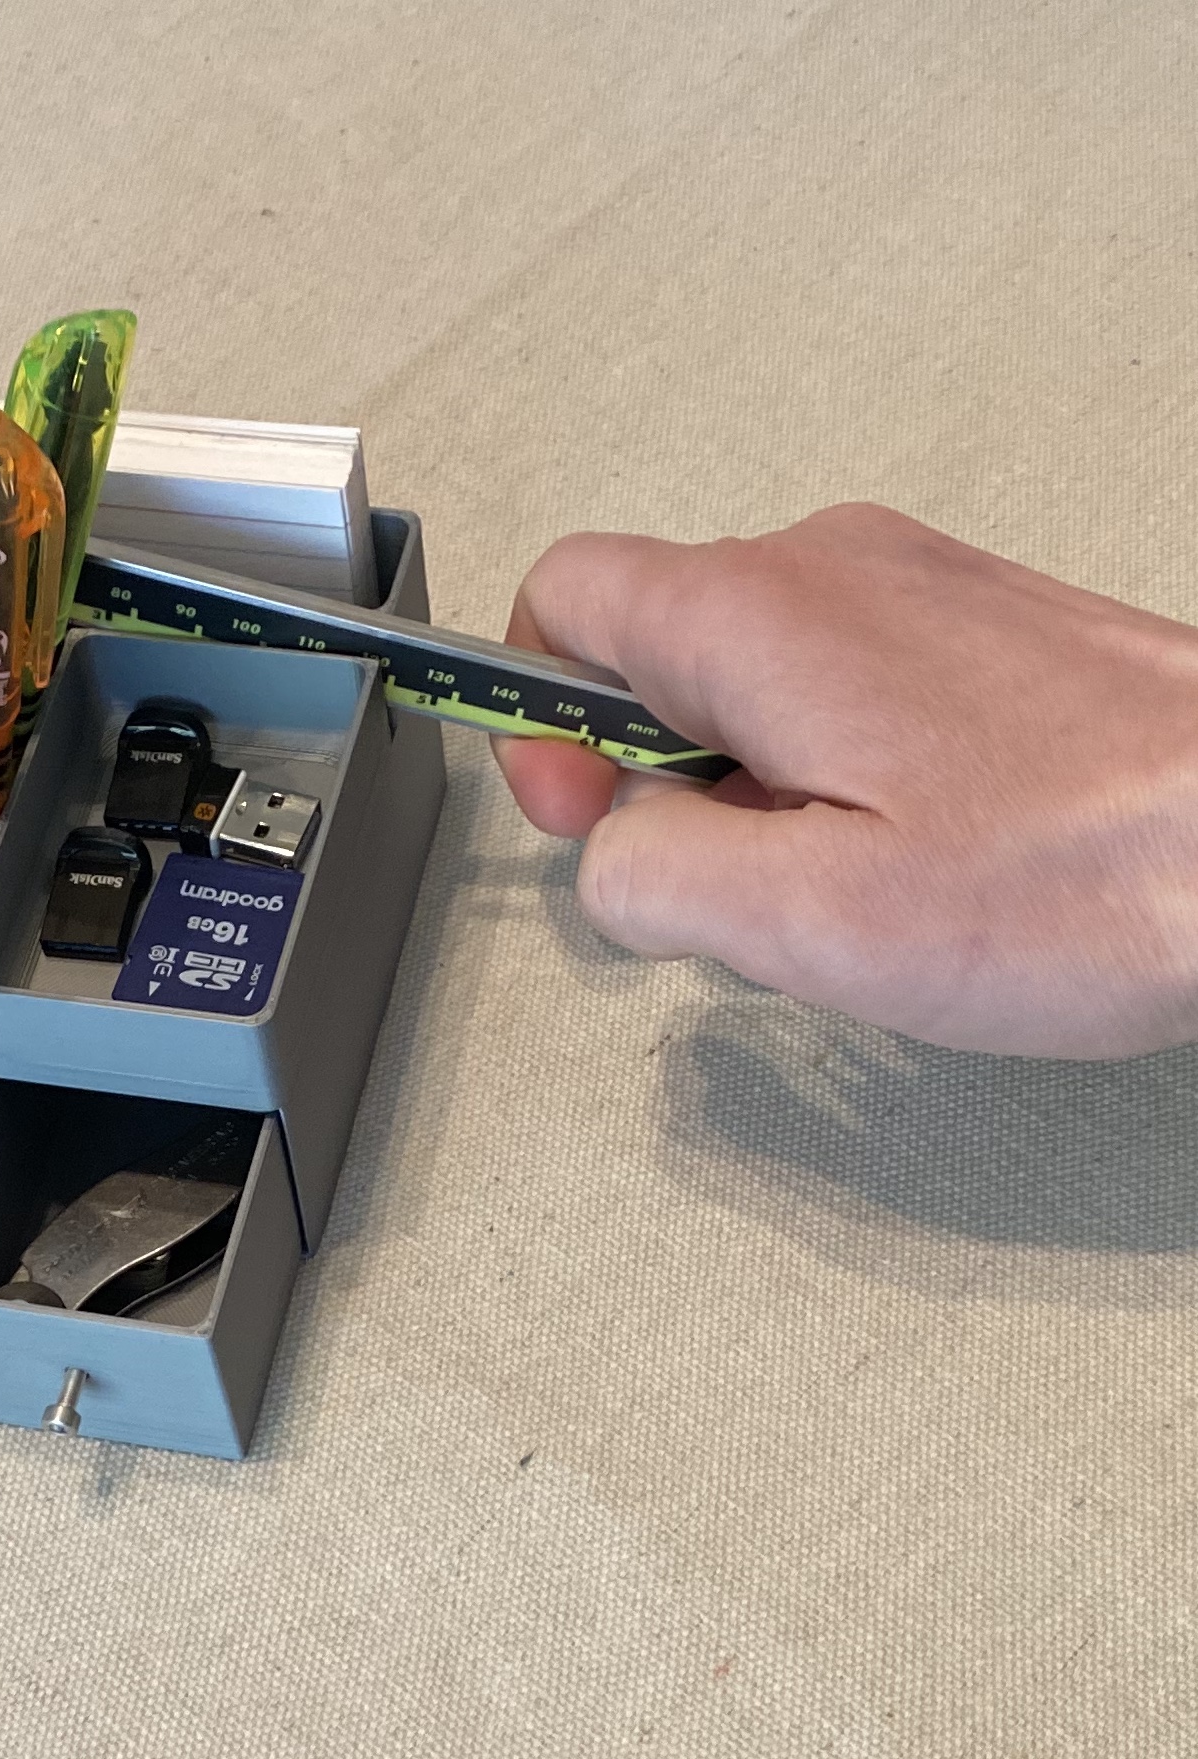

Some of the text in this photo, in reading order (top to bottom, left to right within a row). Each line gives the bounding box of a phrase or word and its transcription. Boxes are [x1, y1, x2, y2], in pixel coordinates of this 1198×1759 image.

[110, 586, 326, 650] 80 90 100 110
[427, 668, 660, 737] 130 140 150 mm
[416, 694, 426, 704] 5
[622, 747, 638, 759] in
[130, 750, 183, 764] SanDisk
[69, 872, 124, 888] SanDisk
[180, 880, 284, 912] goodram
[187, 916, 249, 946] 16GB
[249, 963, 265, 986] LOCK
